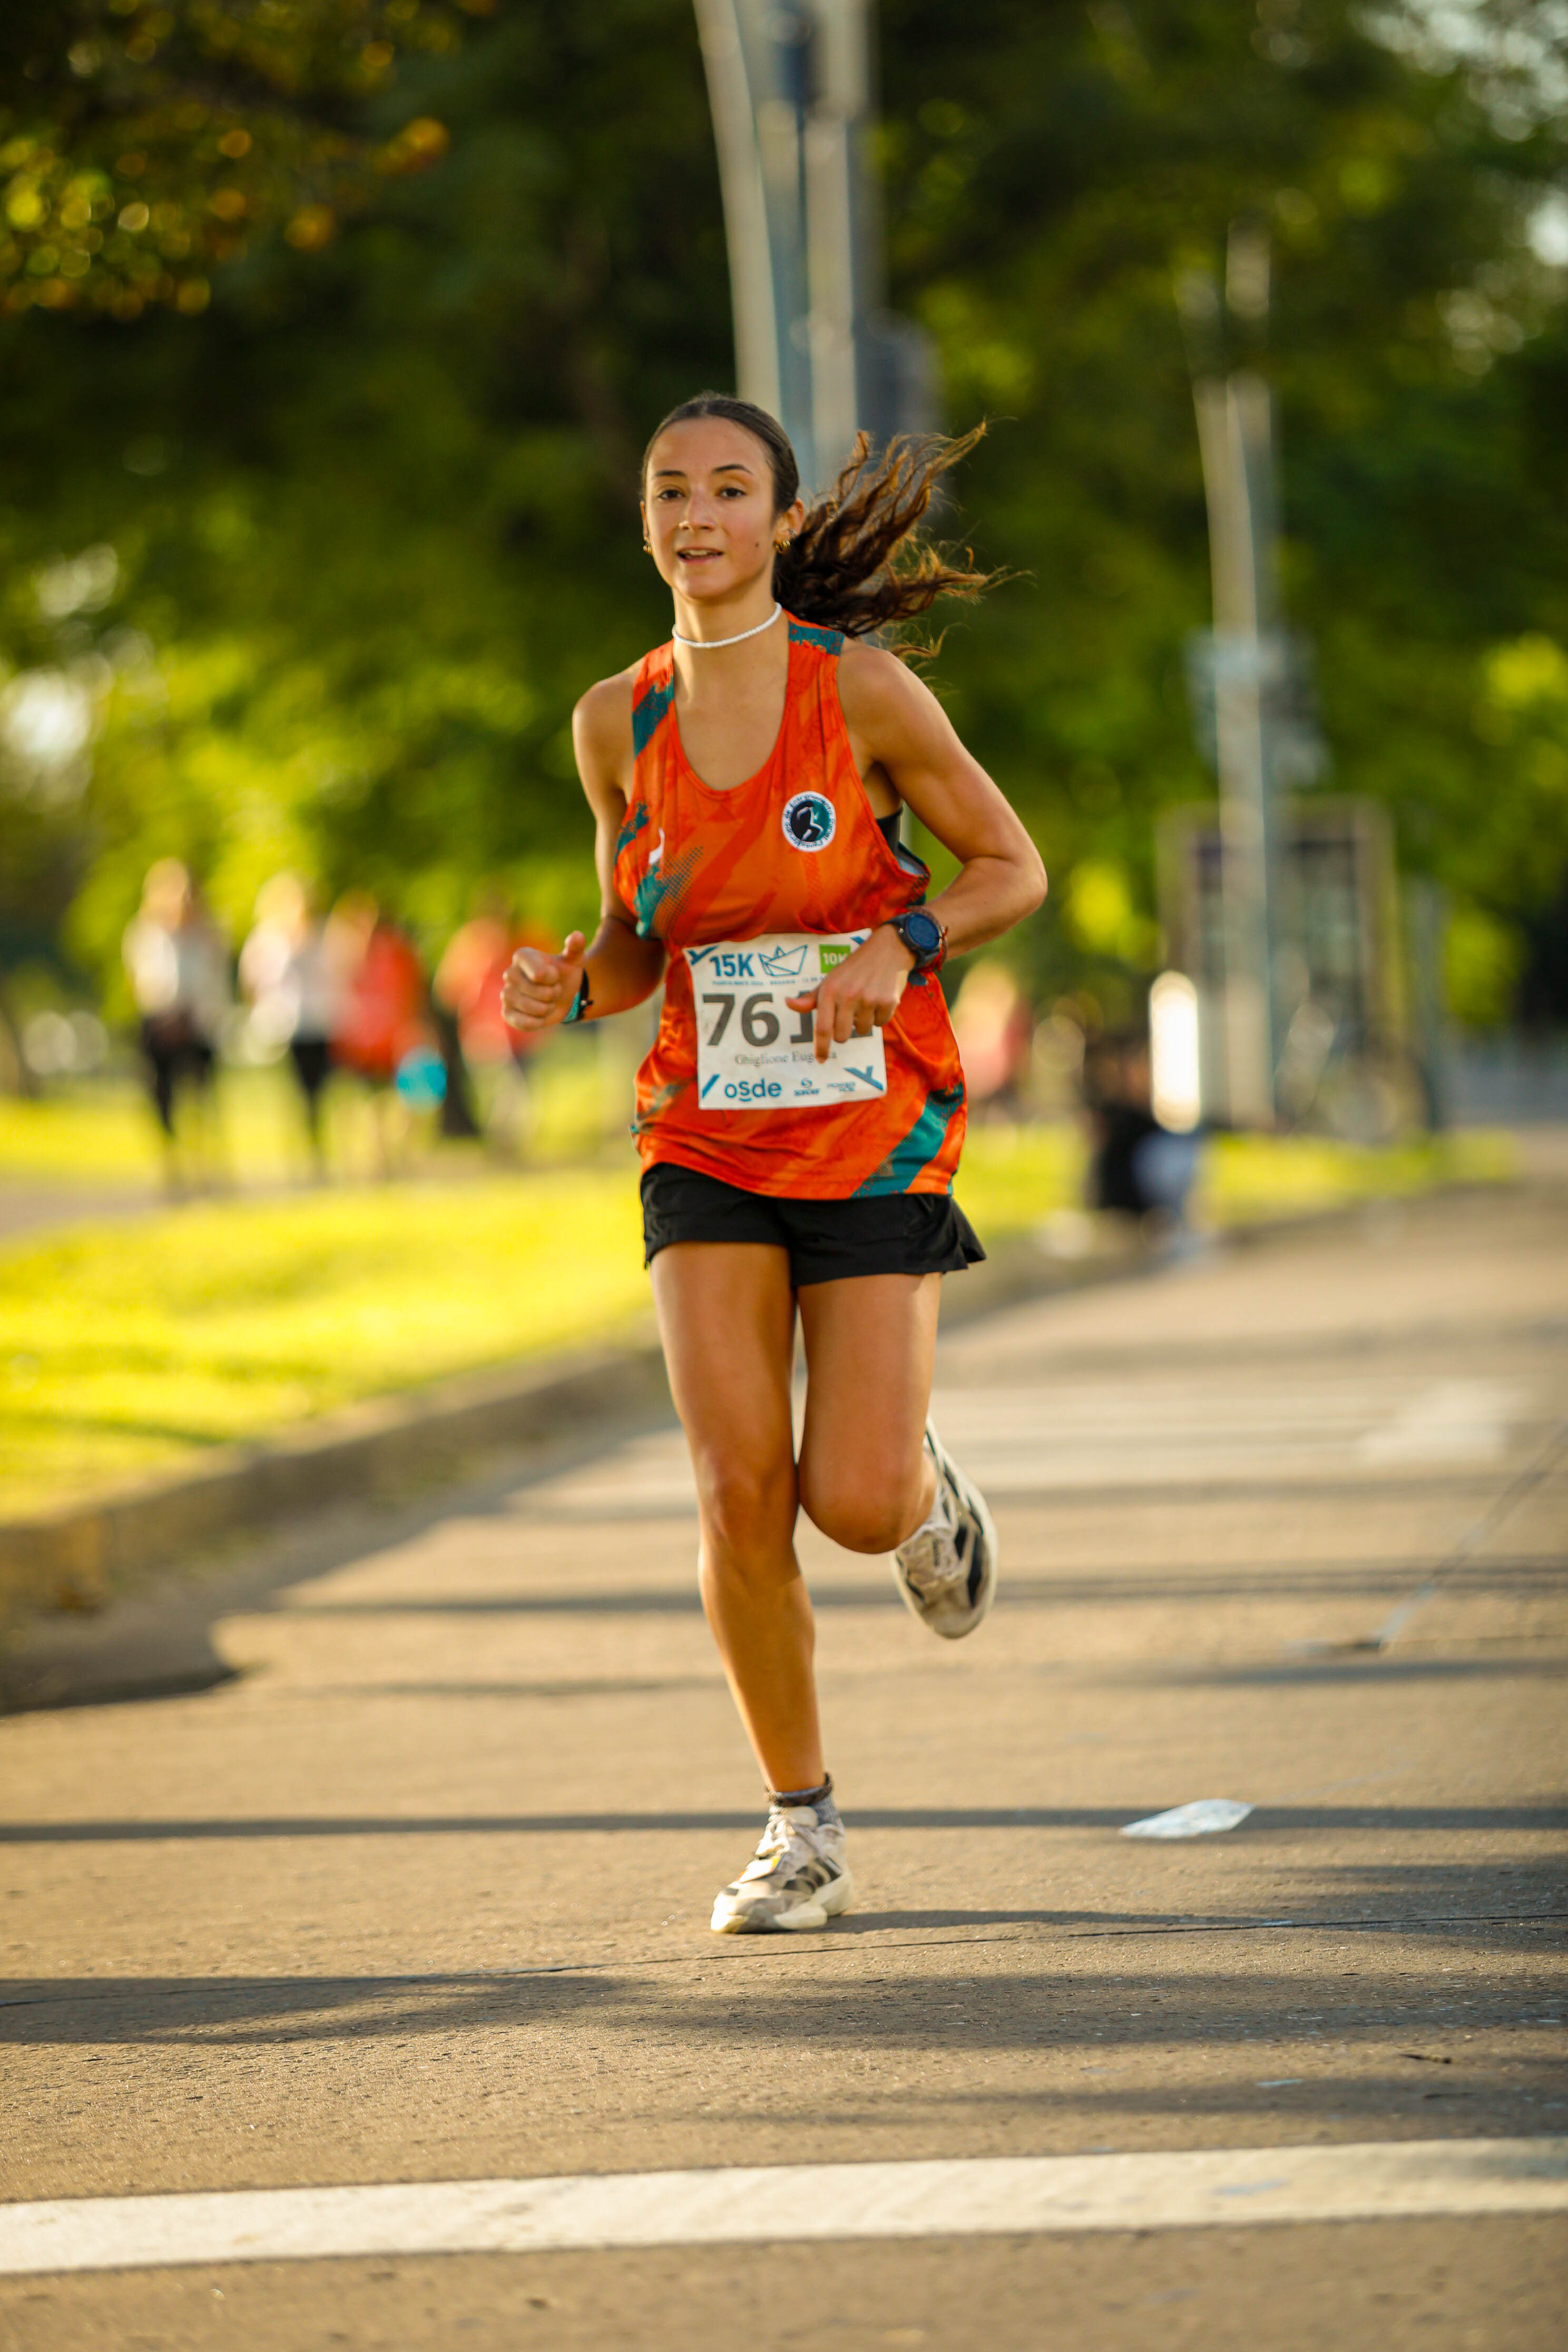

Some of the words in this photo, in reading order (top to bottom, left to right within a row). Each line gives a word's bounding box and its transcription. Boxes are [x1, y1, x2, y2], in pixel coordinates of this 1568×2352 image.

[709, 953, 754, 977] 15K
[702, 991, 874, 1047] 761
[724, 1079, 782, 1102] osde
